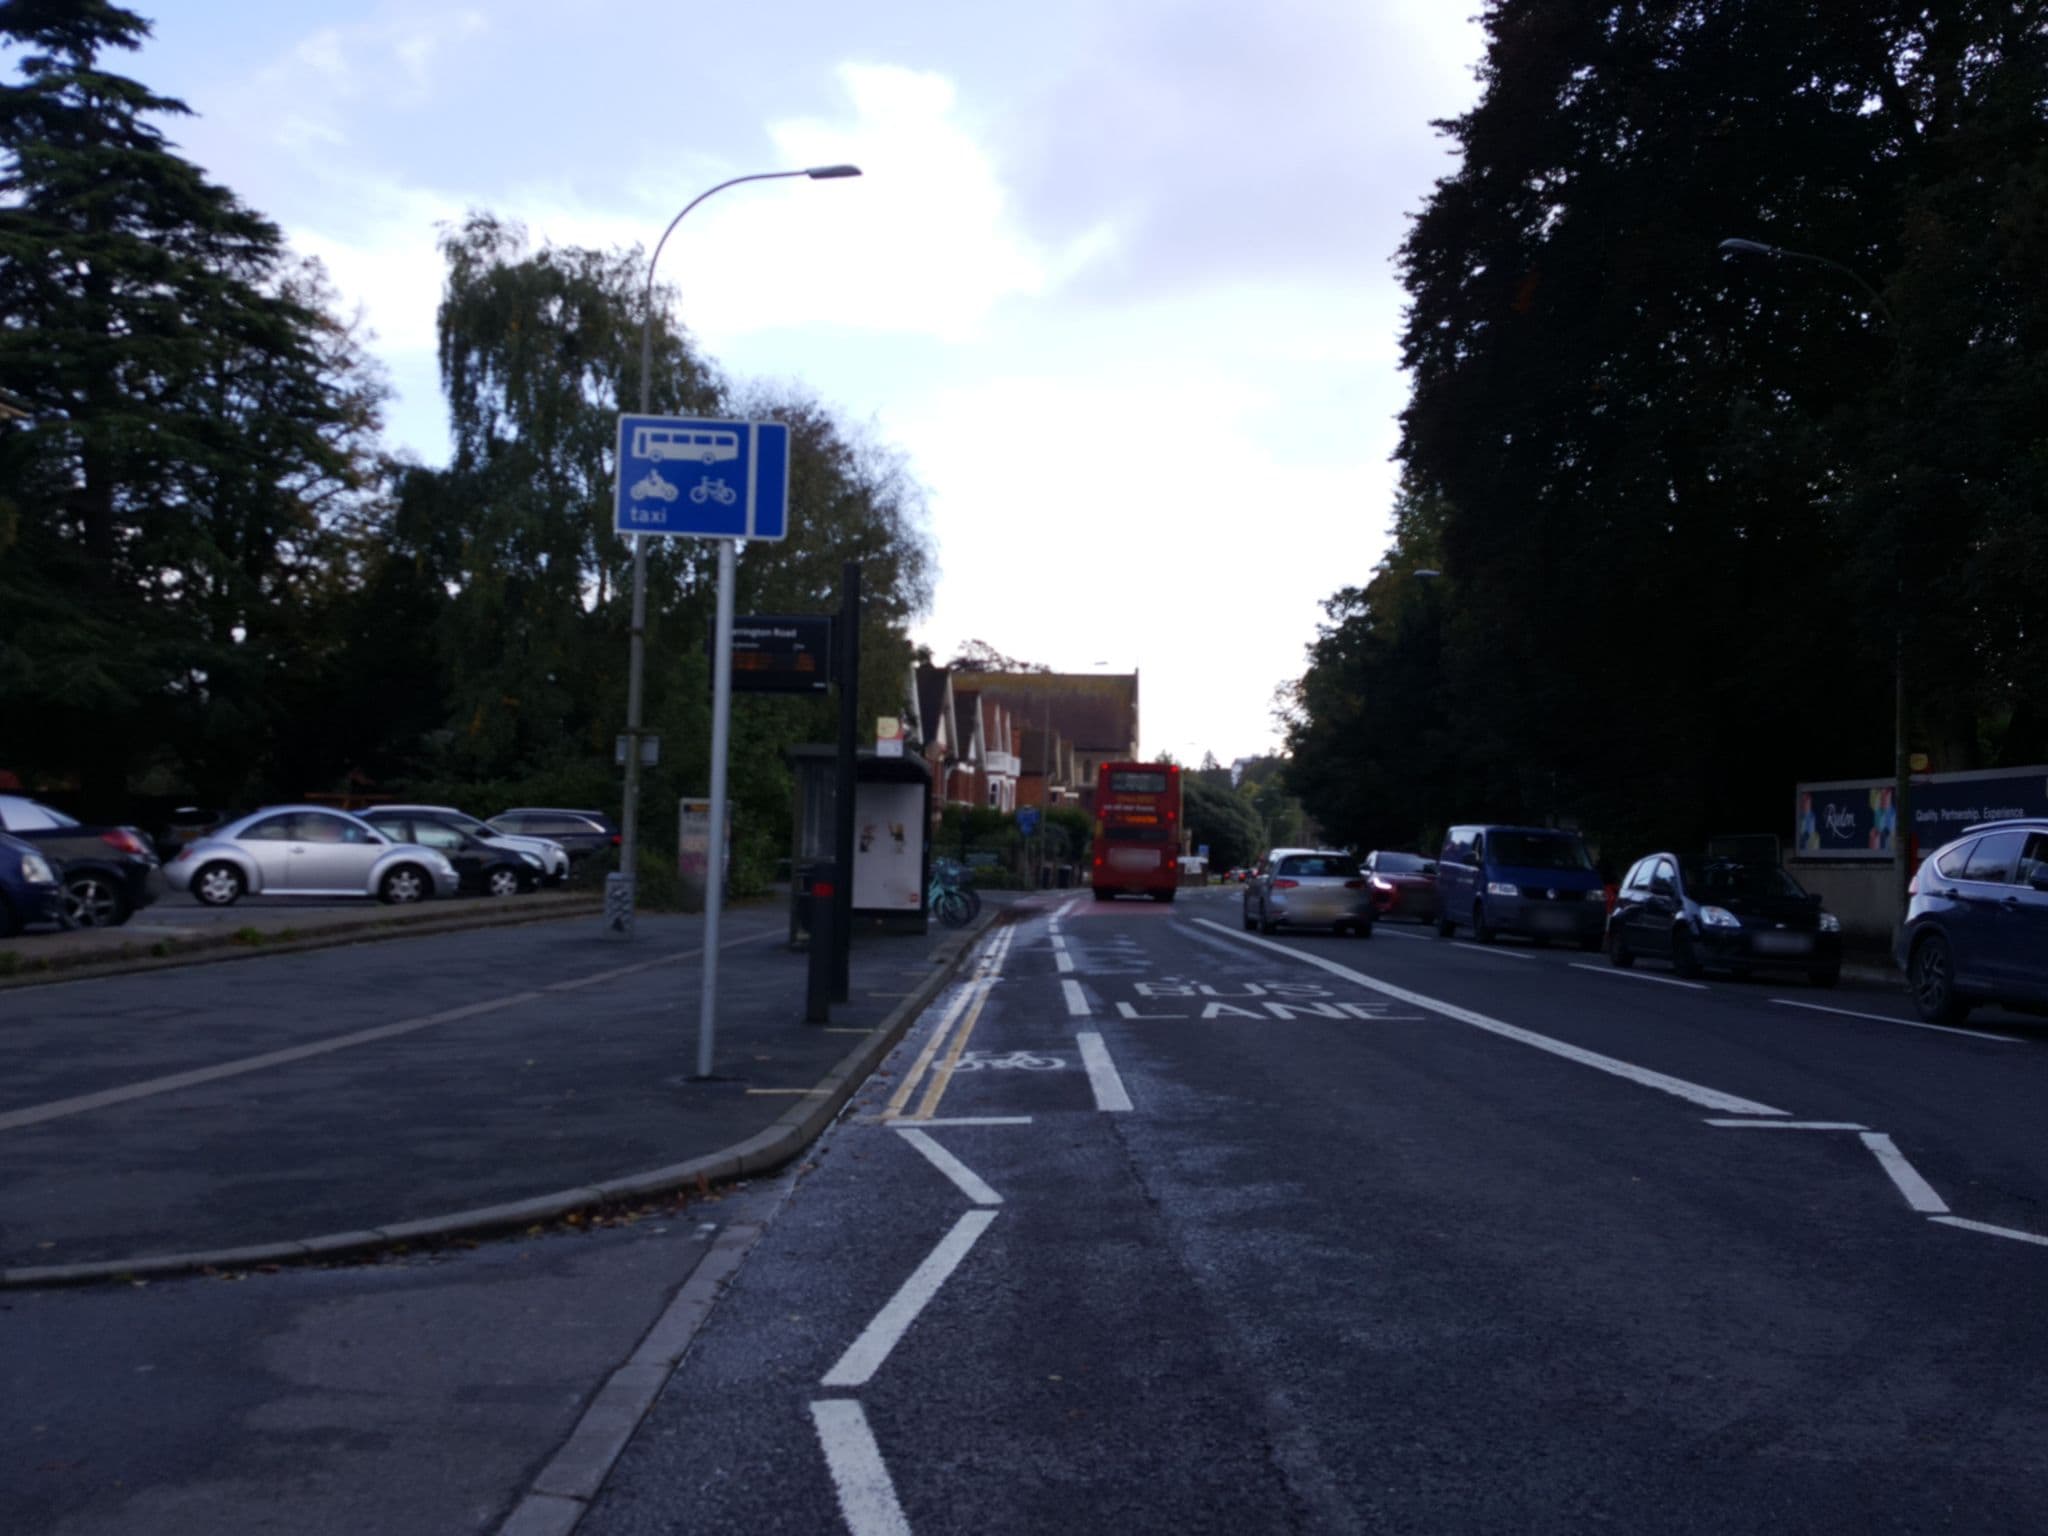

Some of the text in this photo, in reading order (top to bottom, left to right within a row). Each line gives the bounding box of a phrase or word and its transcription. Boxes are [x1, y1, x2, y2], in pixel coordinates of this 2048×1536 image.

[630, 505, 667, 524] taxi
[1133, 982, 1335, 997] BUS
[1116, 1002, 1425, 1019] LANE
